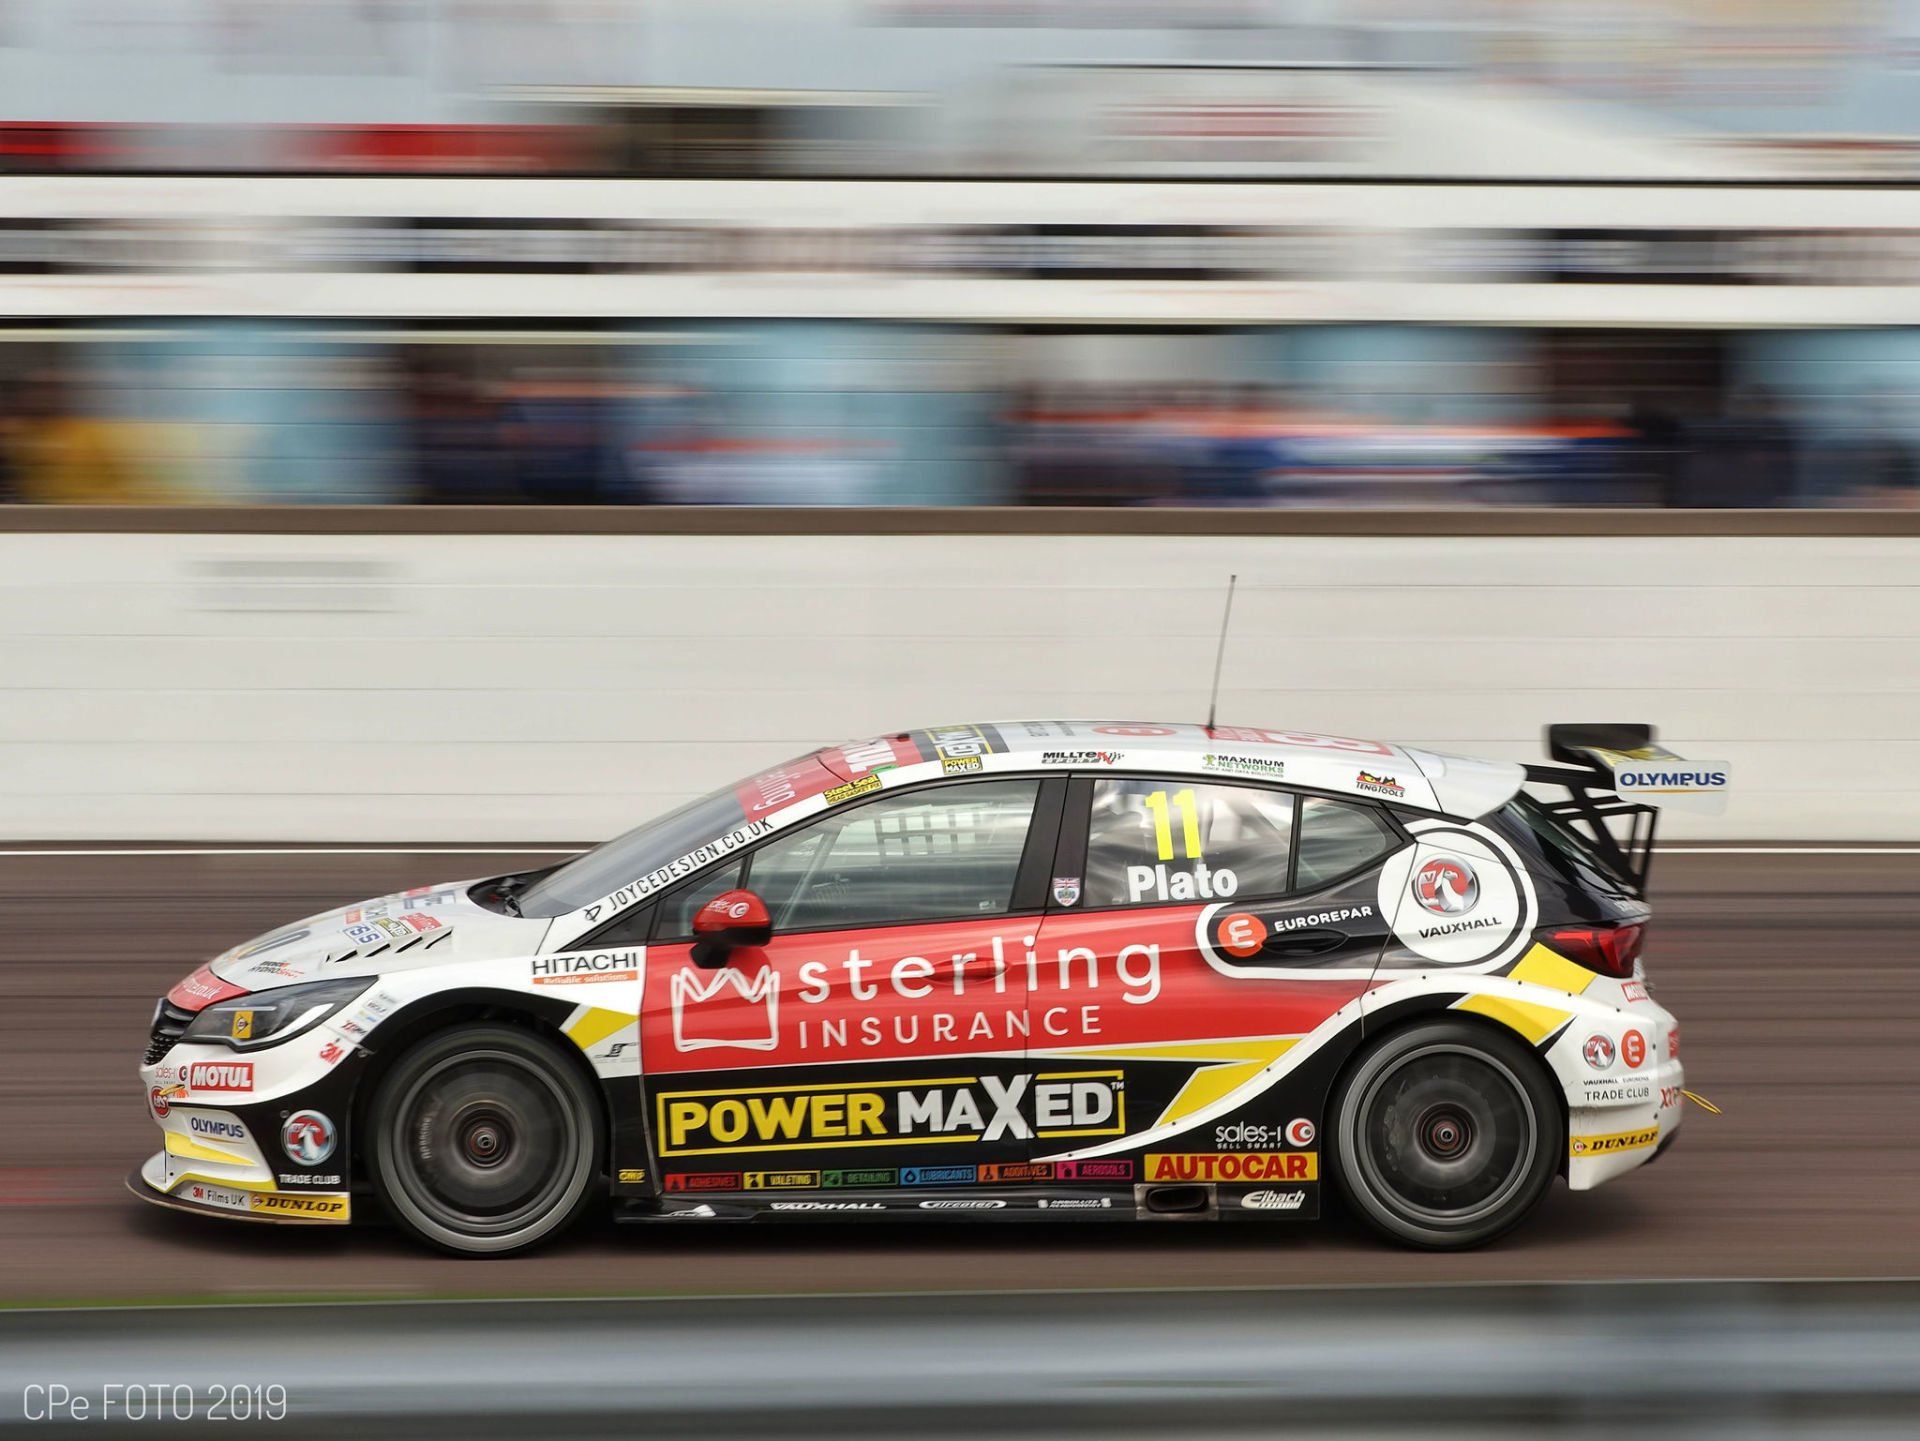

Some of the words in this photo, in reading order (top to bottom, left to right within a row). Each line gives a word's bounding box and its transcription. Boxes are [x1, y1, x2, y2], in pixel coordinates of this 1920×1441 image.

[944, 757, 978, 766] POWER
[945, 763, 980, 773] MAXED
[1218, 755, 1285, 767] MAXIMUM
[1218, 761, 1285, 774] NETWORKS
[824, 782, 853, 797] Steel
[854, 775, 879, 789] Seal
[1619, 772, 1727, 787] OLYMPUS
[1144, 789, 1202, 860] 11
[609, 817, 773, 911] JOYCEDESIGN.CO.UK
[1127, 863, 1238, 902] Plato
[1274, 906, 1373, 932] EUROREPAR
[1419, 917, 1502, 939] VAUXHALL
[532, 952, 637, 975] HITACHI
[798, 935, 1161, 1004] sterling
[799, 1005, 1102, 1048] INSURANCE
[192, 1065, 252, 1087] MOTUL
[1583, 1078, 1618, 1086] VAUXHALL
[1585, 1089, 1624, 1101] TRADE
[1626, 1087, 1649, 1098] CLUB
[670, 1093, 887, 1146] POWER
[898, 1073, 1114, 1142] MAXED
[191, 1117, 244, 1140] OLYMPUS
[1217, 1142, 1241, 1150] SELL
[1247, 1141, 1282, 1149] SMART
[920, 1168, 973, 1181] LUBRICANTS
[1003, 1165, 1048, 1177] ADDITIVES
[1082, 1164, 1126, 1176] AEROSOLS
[1154, 1155, 1308, 1180] AUTOCAR
[279, 1174, 312, 1185] TRADE
[313, 1174, 341, 1185] CLUB
[770, 1174, 811, 1185] VALETING
[192, 1186, 204, 1199] 3M
[207, 1189, 229, 1205] Films
[231, 1194, 245, 1206] UK
[265, 1197, 344, 1213] DUNLOP
[770, 1202, 887, 1210] VAUXHALL
